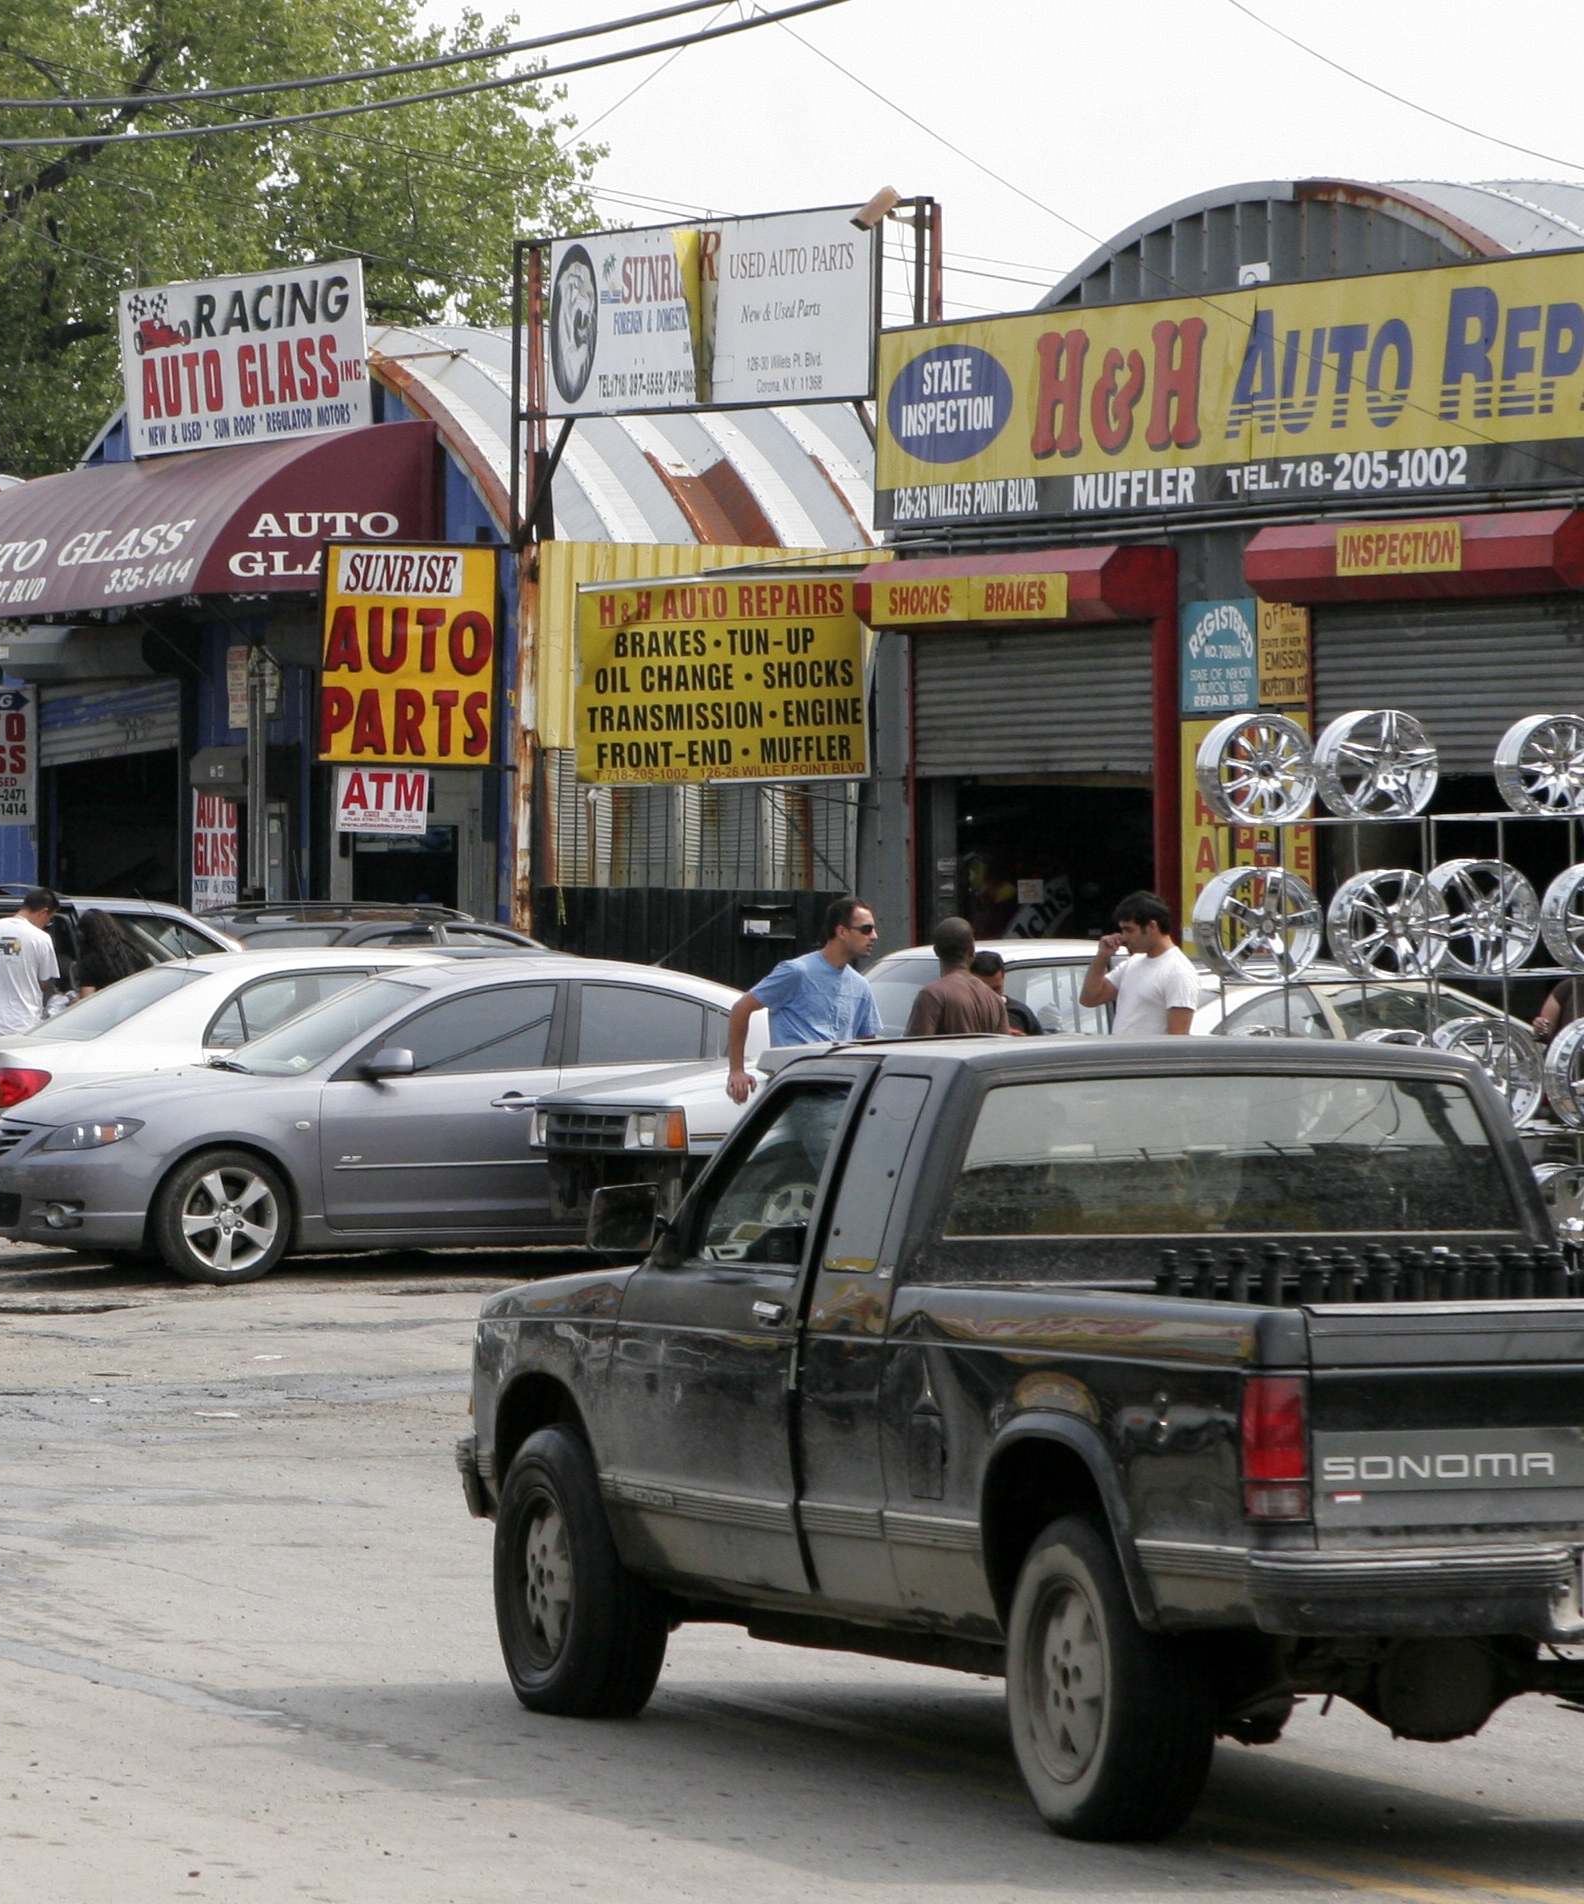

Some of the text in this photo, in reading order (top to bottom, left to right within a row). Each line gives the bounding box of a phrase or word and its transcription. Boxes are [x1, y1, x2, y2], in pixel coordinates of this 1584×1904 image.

[730, 243, 854, 280] USED AUTO PARTS
[191, 276, 350, 339] RACING
[613, 310, 643, 336] FOREIGN
[740, 299, 821, 324] New & Used Parts
[142, 334, 366, 420] AUTO GLASS INC.
[922, 358, 973, 395] STATE
[1030, 317, 1208, 460] H&H
[1225, 309, 1413, 439] AUTO
[148, 403, 350, 446] NEW & USED SUN ROOF REGULATOR MOTORS
[901, 396, 993, 438] INSPECTION
[893, 478, 1038, 521] 126-26 WILLETS POINT BLVD.
[1073, 467, 1195, 511] MUFFLER
[57, 518, 197, 567] GLASS
[248, 511, 399, 538] AUTO
[1341, 530, 1455, 568] INSPECTION
[7, 577, 46, 603] BLVD
[104, 558, 194, 595] 335-1414
[345, 552, 458, 593] SUNRISE
[599, 583, 845, 626] H & H AUTO REPAIRS
[889, 585, 950, 616] SHOCKS
[985, 581, 1047, 613] BRAKES
[324, 606, 493, 675] AUTO
[614, 627, 815, 659] BRAKES TUN-UP
[1189, 606, 1253, 659] REGISTERED
[595, 659, 854, 694] OIL CHANGE SHOCKS
[587, 697, 863, 733] TRANSMISSION ENGINE
[1194, 695, 1229, 707] REPAIR
[319, 686, 489, 757] PARTS
[596, 735, 851, 770] FRONT-END MUFFLER
[700, 767, 739, 779] 126-26
[742, 765, 788, 778] WILLET
[792, 763, 829, 775] POINT
[832, 762, 865, 775] BLVD
[341, 772, 425, 811] ATM
[194, 833, 238, 876] GLASS
[1322, 1451, 1555, 1481] SONOMA
